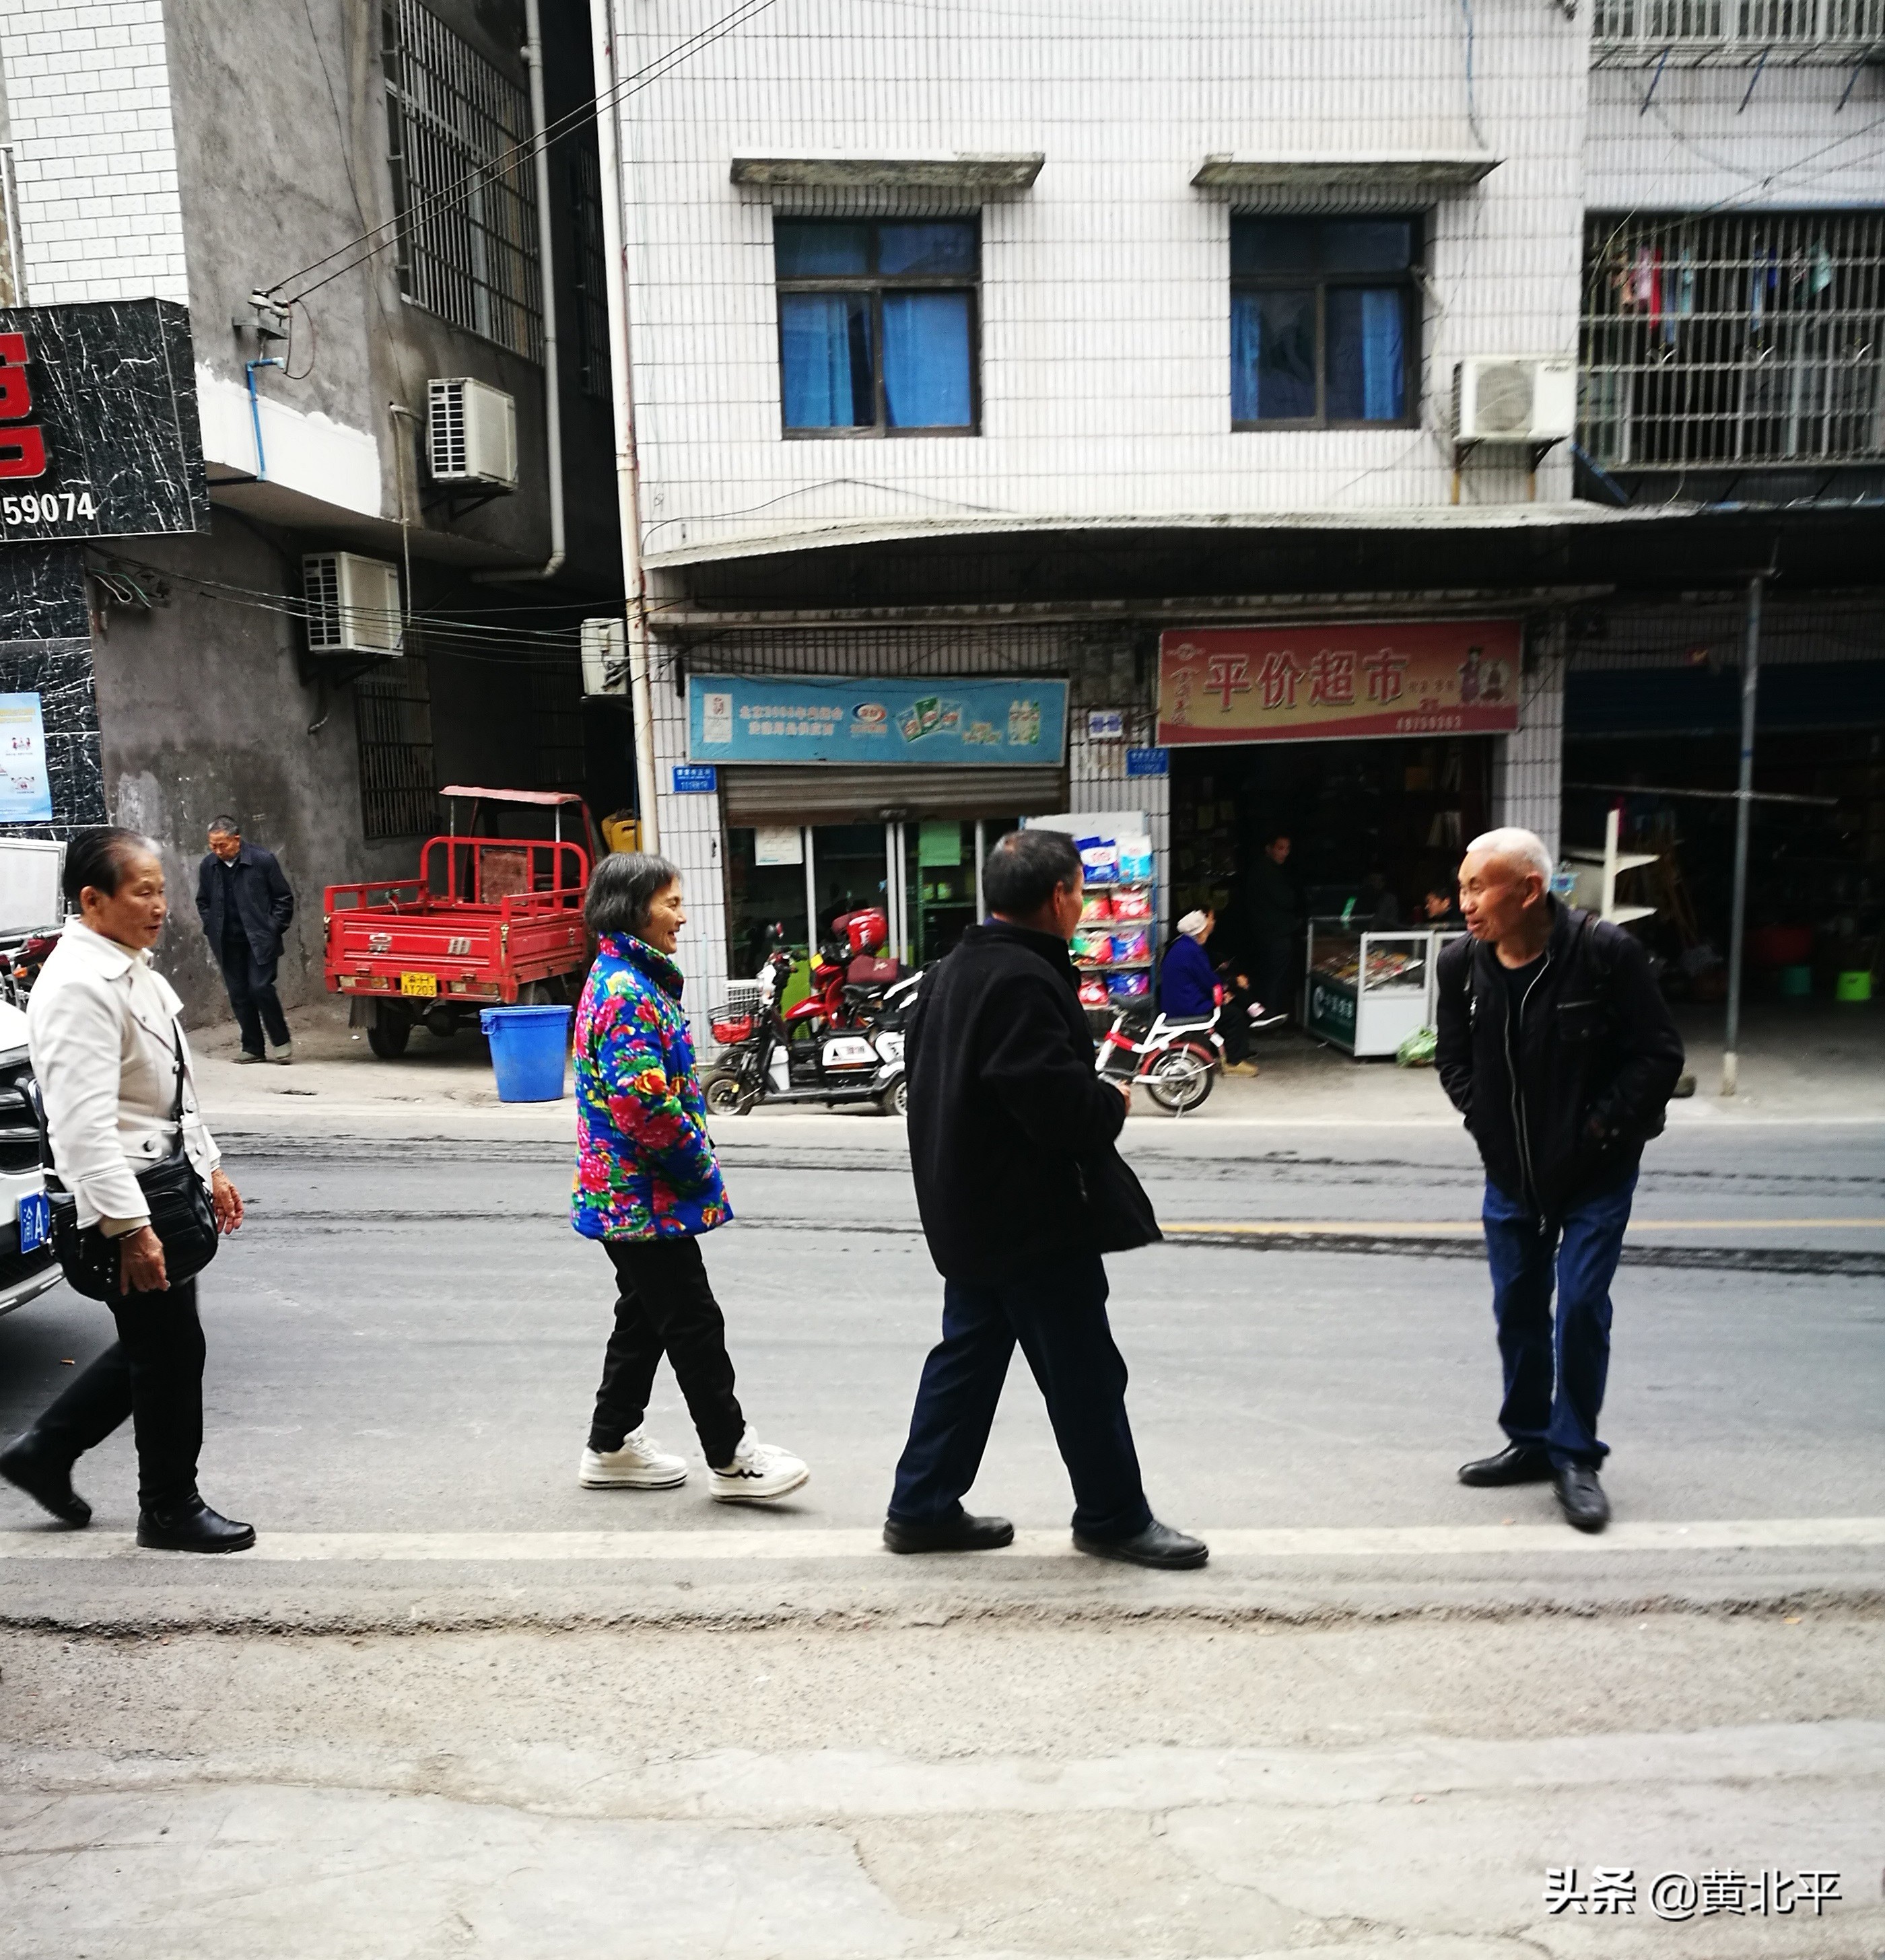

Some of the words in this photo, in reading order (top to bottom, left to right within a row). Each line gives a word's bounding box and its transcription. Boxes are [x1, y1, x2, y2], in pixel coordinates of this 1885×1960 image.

[3, 492, 98, 525] 59074
[1203, 647, 1410, 711] 平价超市
